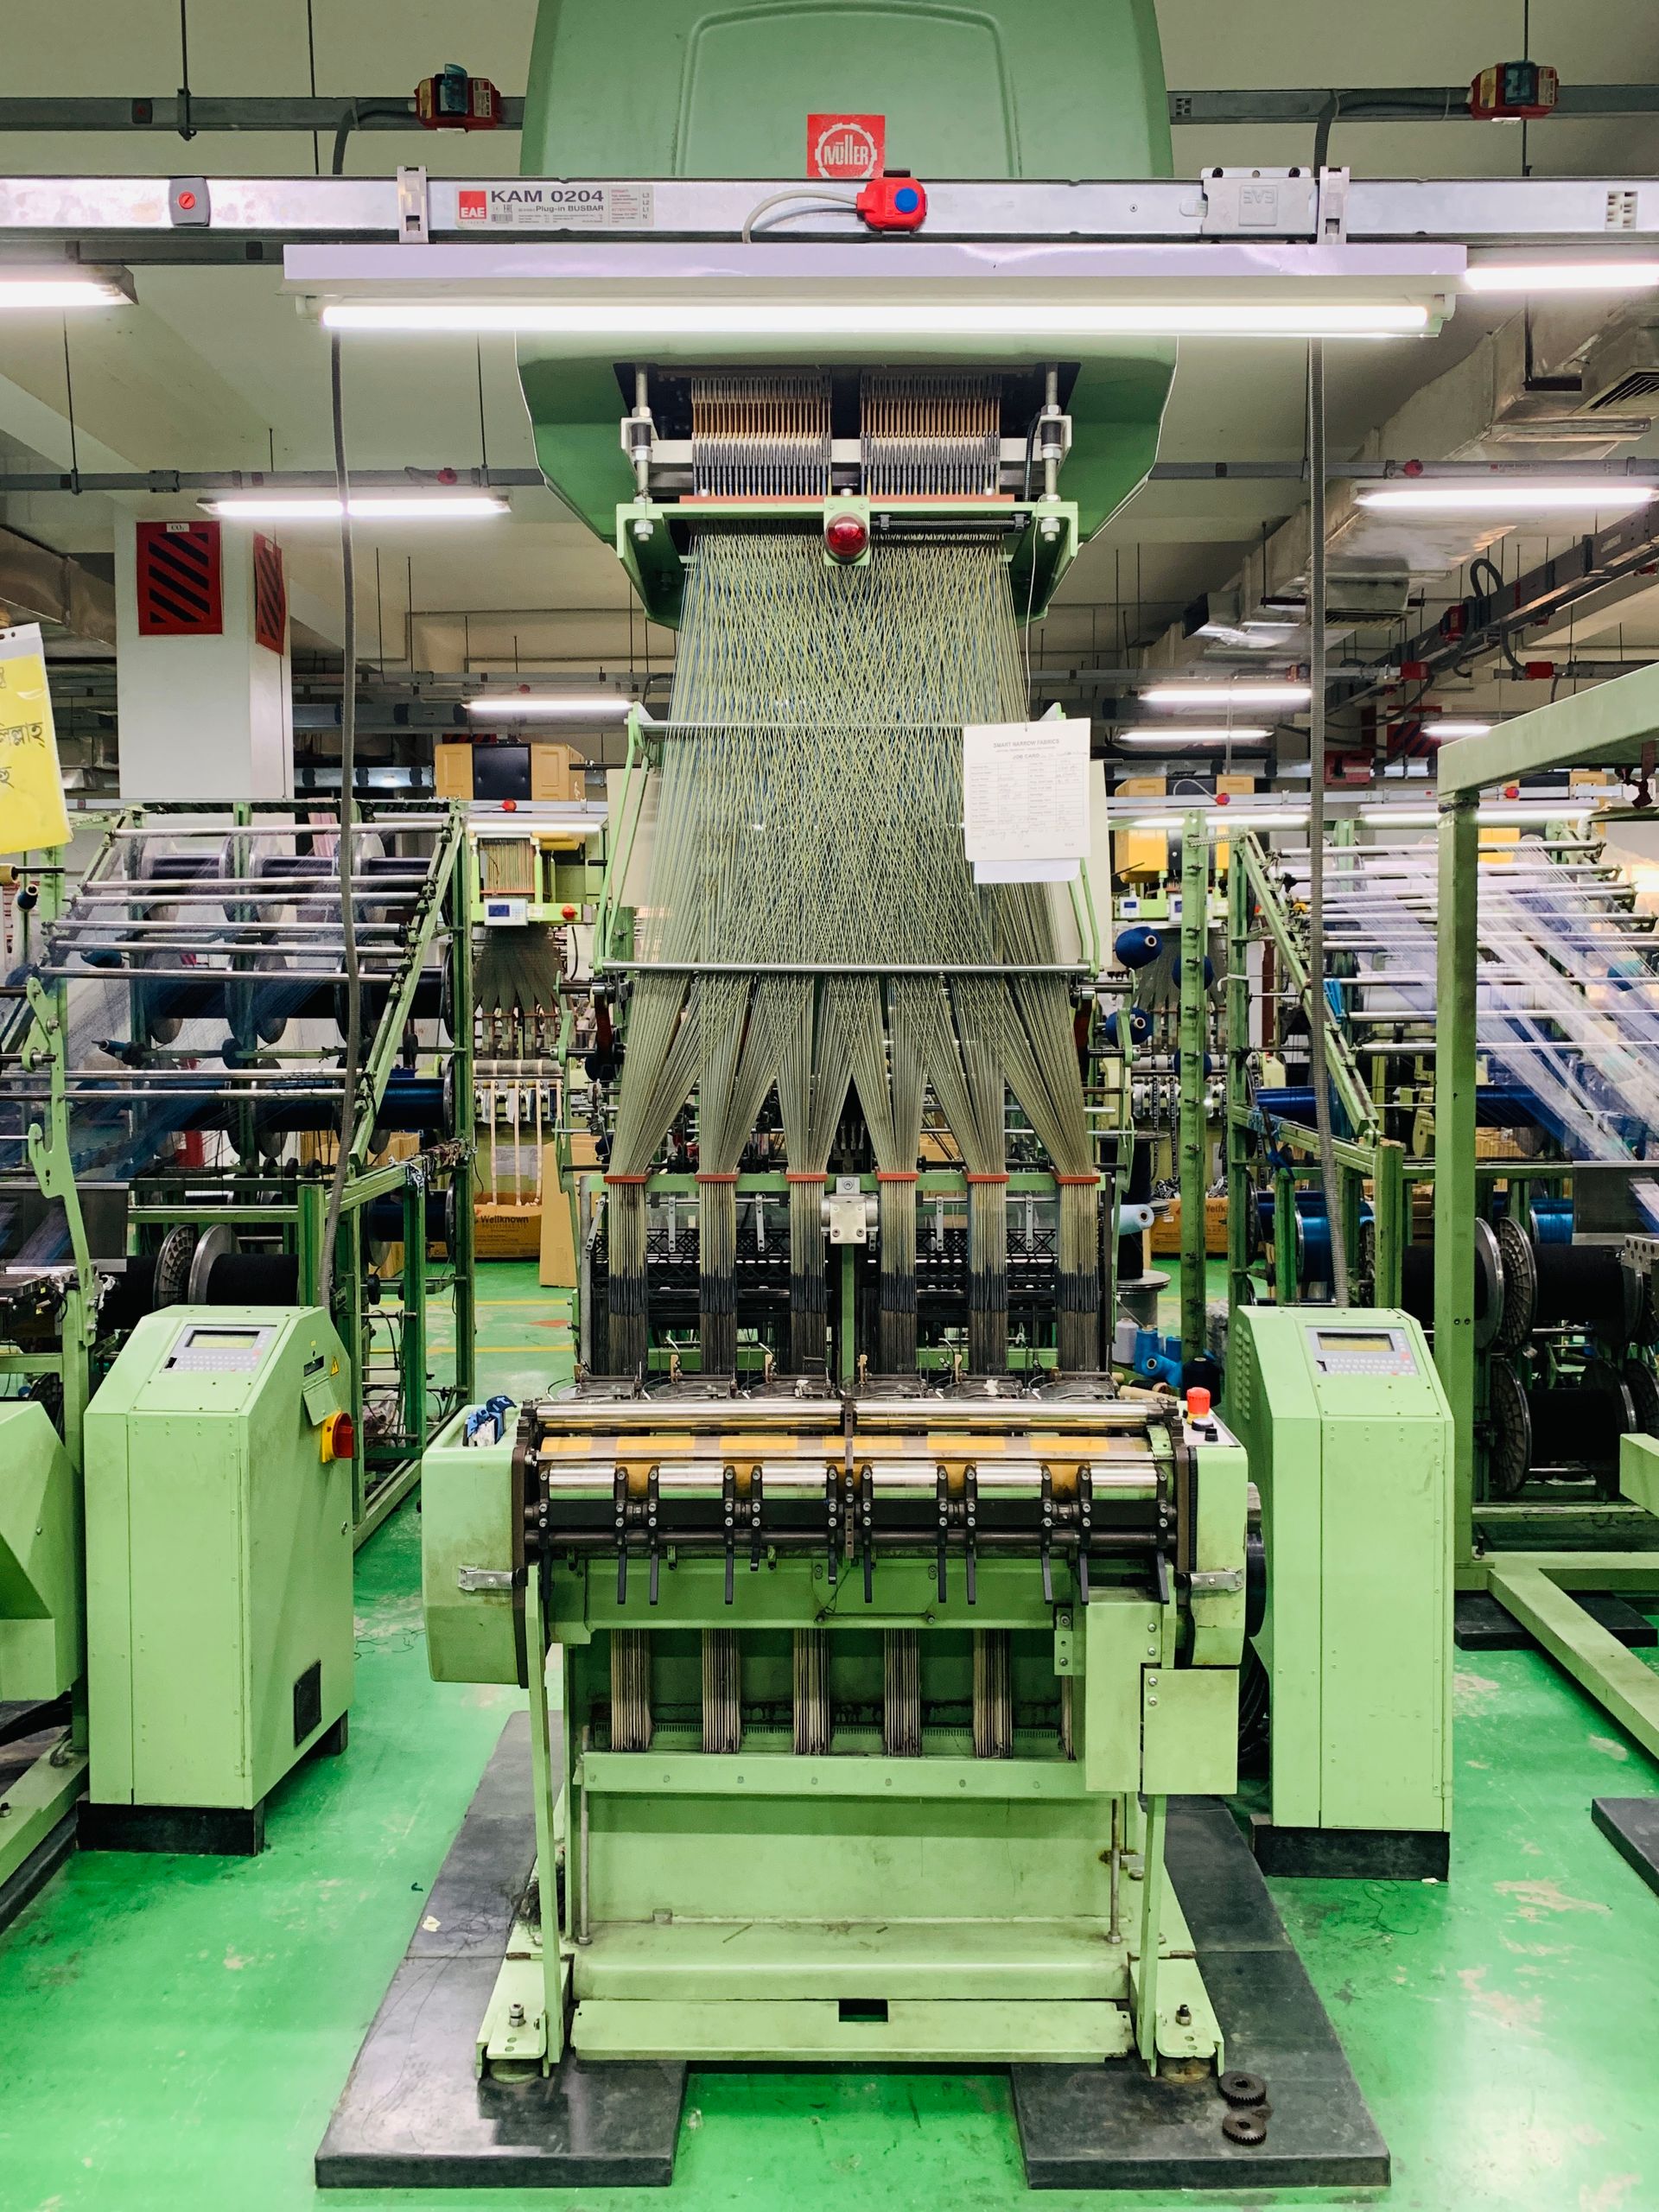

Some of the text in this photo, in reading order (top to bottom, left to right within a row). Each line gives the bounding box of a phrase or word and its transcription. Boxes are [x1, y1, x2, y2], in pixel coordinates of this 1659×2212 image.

[491, 190, 543, 202] KAM
[550, 190, 604, 202] 0204
[461, 207, 486, 218] EAE
